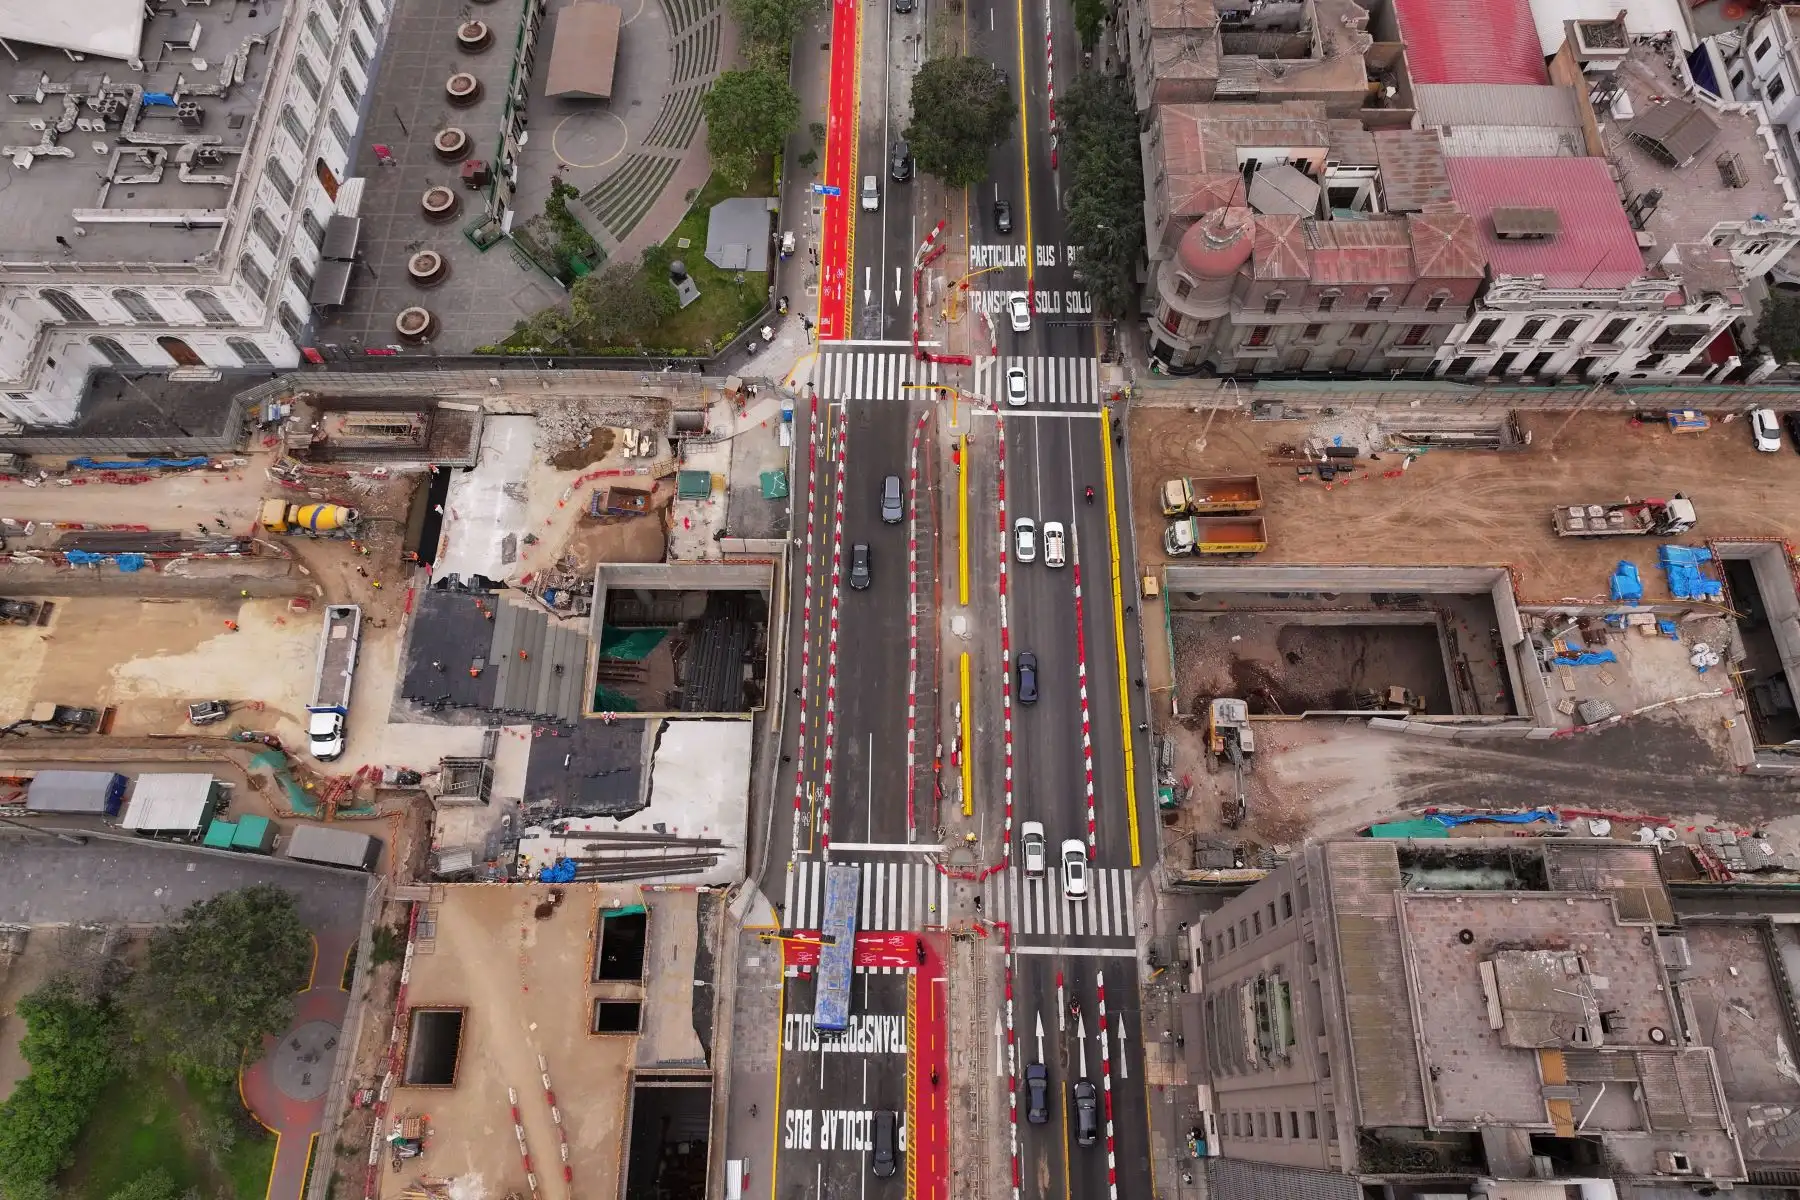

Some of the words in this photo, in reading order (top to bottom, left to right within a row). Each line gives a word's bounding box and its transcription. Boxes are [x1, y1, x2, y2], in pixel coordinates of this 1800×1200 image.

[970, 245, 1026, 267] PARTICULAR
[1036, 245, 1055, 266] BUS
[1067, 246, 1085, 266] BU
[969, 291, 1029, 313] TRANSPO
[1035, 291, 1060, 313] SOLO
[1066, 291, 1091, 313] SOLO
[784, 1109, 813, 1149] BUS
[821, 1110, 907, 1152] PICULAR
